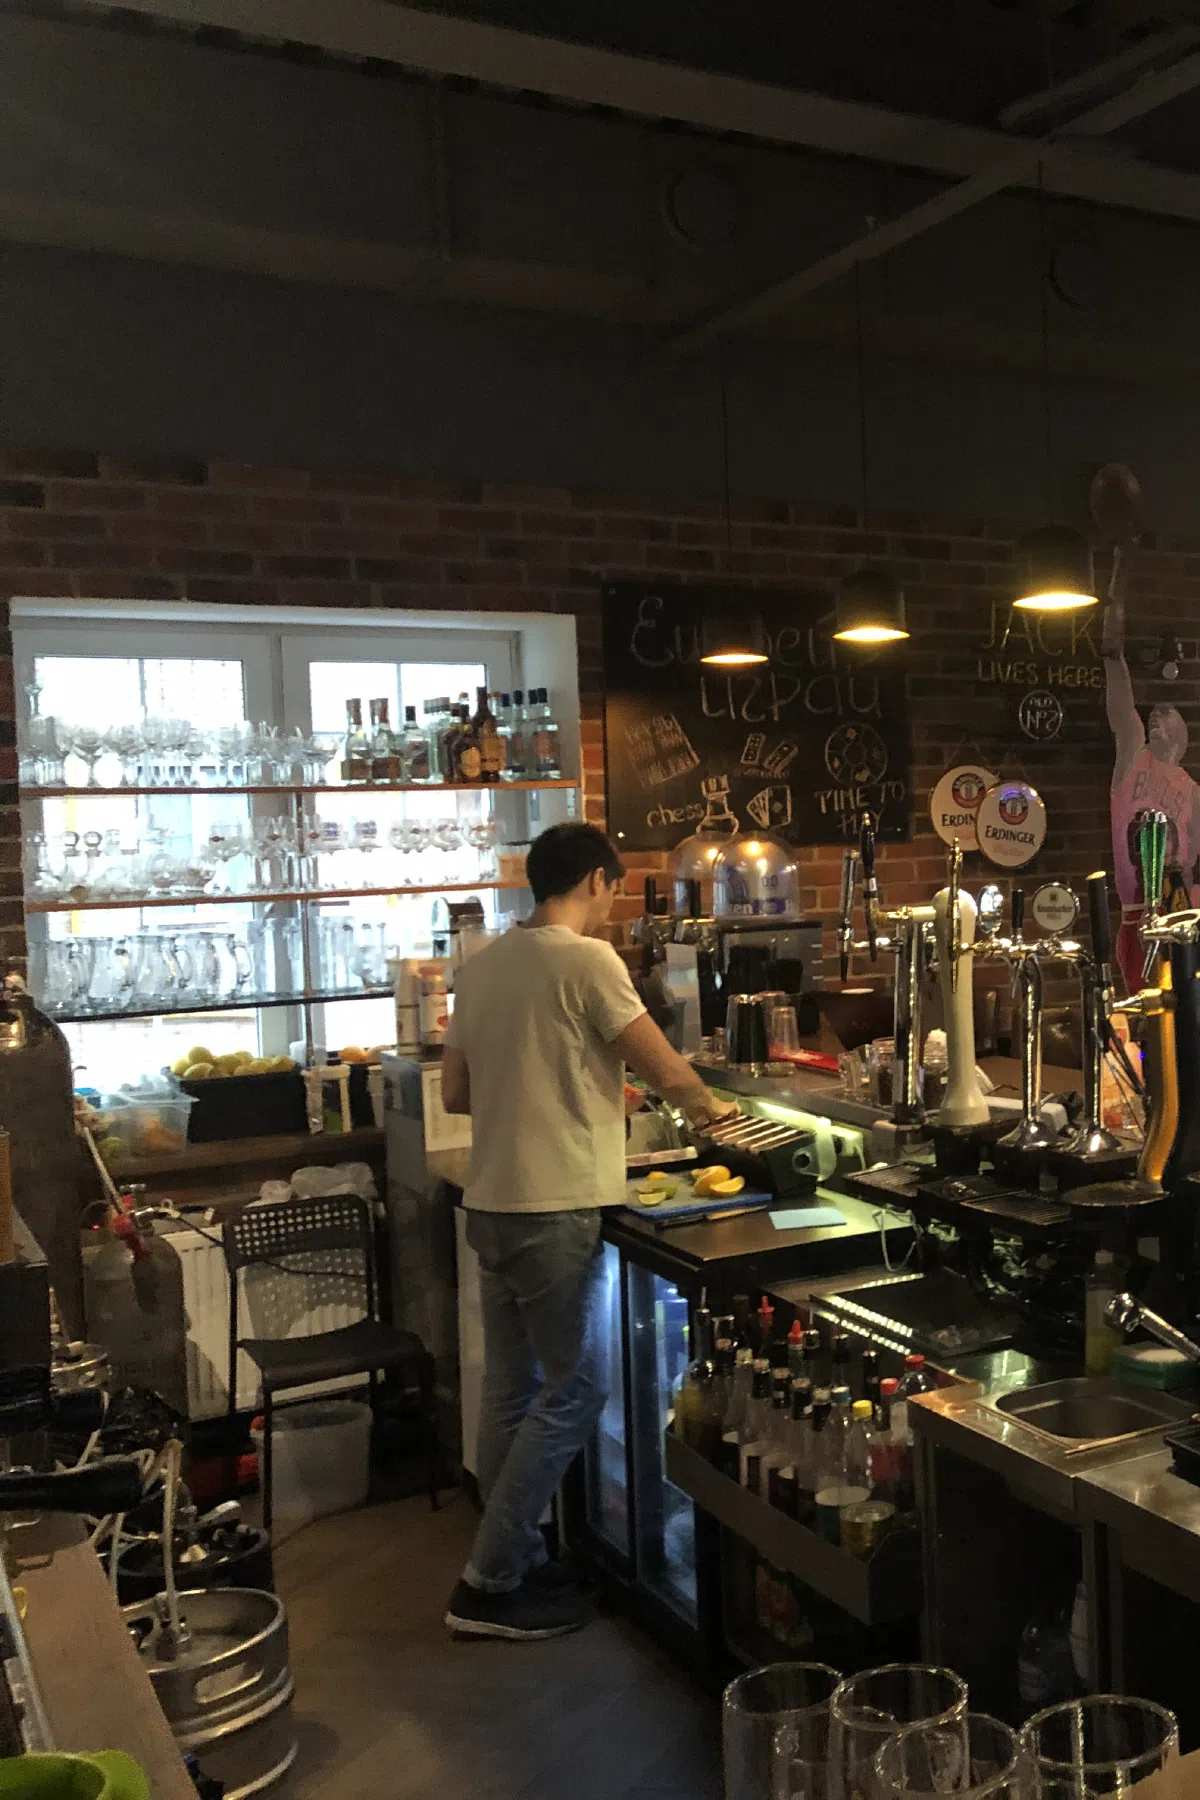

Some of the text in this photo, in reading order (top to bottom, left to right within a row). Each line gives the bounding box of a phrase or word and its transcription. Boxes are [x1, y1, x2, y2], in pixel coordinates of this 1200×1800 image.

[977, 659, 1038, 685] LIVES
[646, 802, 705, 829] chess
[941, 813, 977, 827] ERDIN
[984, 824, 1036, 845] ERDINGER
